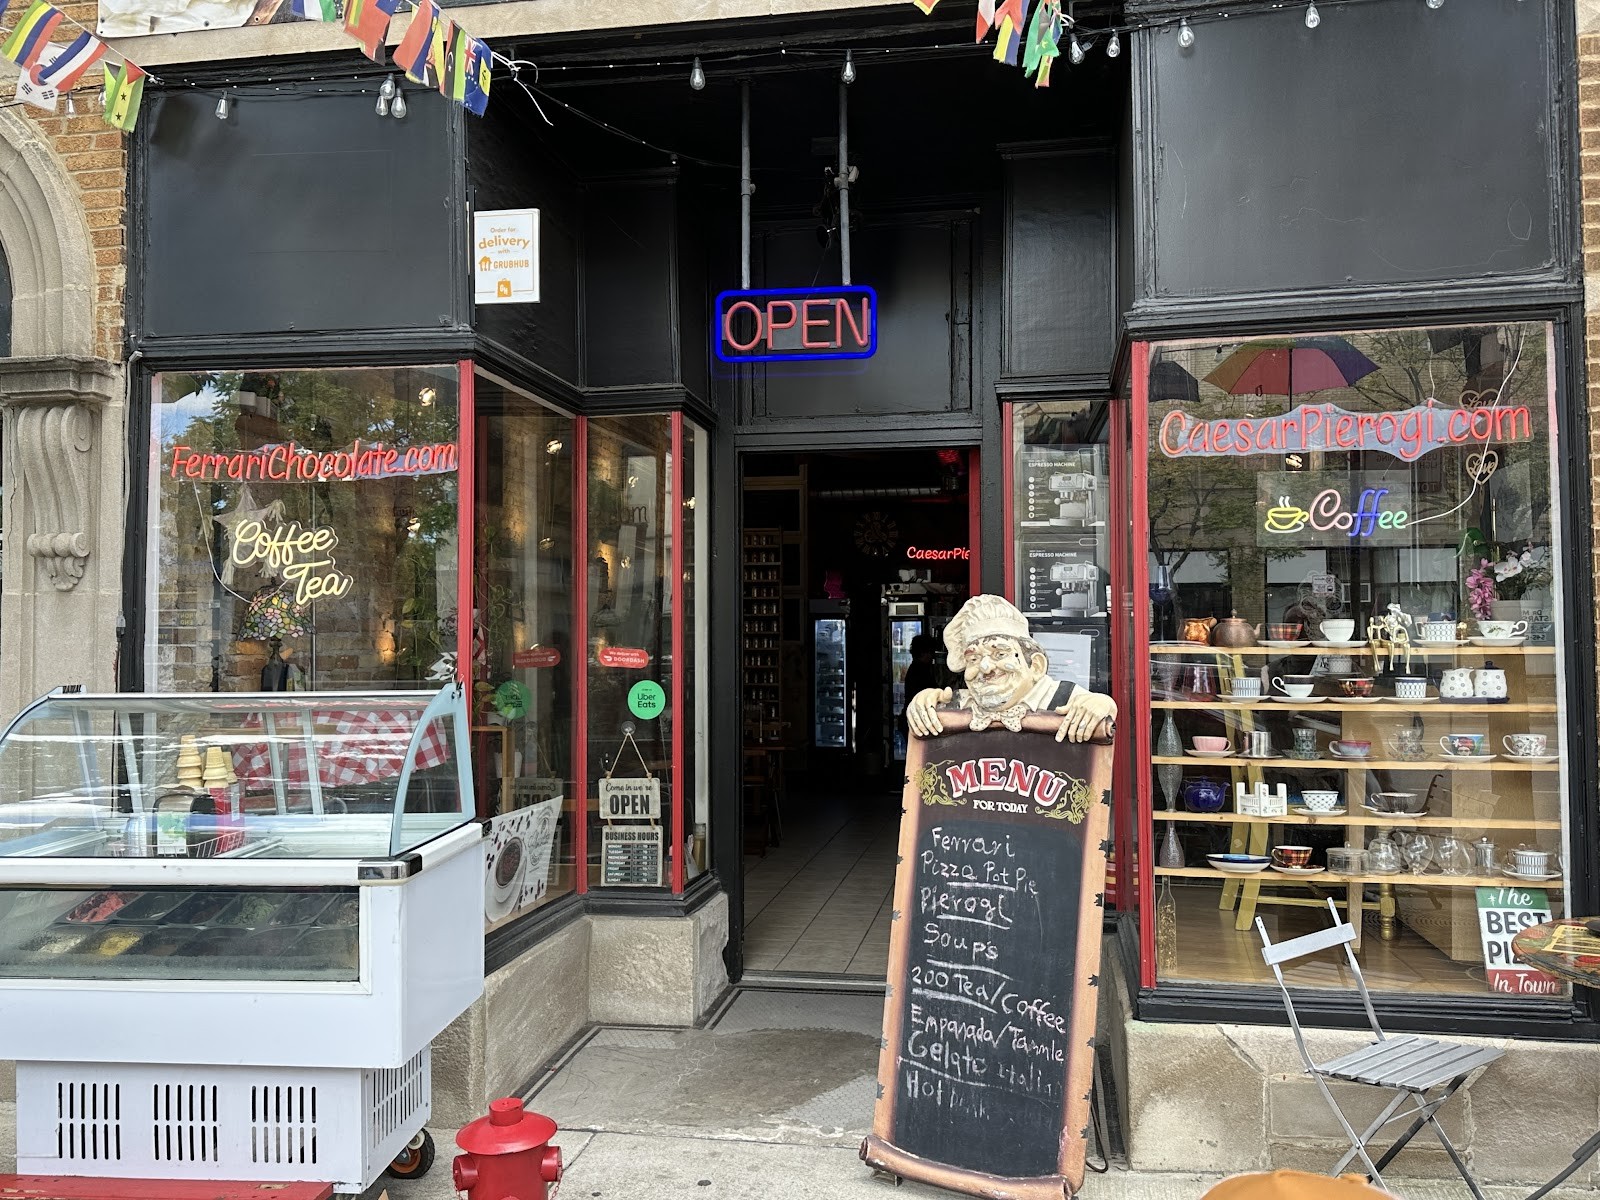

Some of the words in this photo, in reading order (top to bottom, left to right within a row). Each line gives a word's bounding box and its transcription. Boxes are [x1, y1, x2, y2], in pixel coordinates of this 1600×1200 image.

[478, 235, 530, 250] delivery
[493, 259, 529, 269] GRUBHUB
[725, 297, 868, 350] OPEN
[1162, 398, 1531, 459] CaesarPierogi.com
[171, 440, 457, 480] FerrariChocolate.com
[1310, 488, 1408, 537] Coffee
[233, 519, 334, 567] Coffee
[283, 560, 350, 605] Tea
[605, 782, 624, 791] Come
[946, 757, 1067, 807] MENU
[609, 795, 650, 814] OPEN
[973, 799, 995, 811] FOR
[997, 801, 1028, 814] TODAY
[605, 832, 636, 840] BUSINESS
[637, 832, 659, 840] HOURS
[931, 826, 1016, 858] Ferrari
[921, 850, 978, 880] Pizza
[983, 860, 1009, 884] Pot
[1015, 867, 1039, 896] Pie
[1495, 887, 1534, 906] The
[924, 923, 999, 960] Soups
[911, 966, 949, 988] 200
[1493, 972, 1513, 993] In
[1516, 973, 1556, 993] Town
